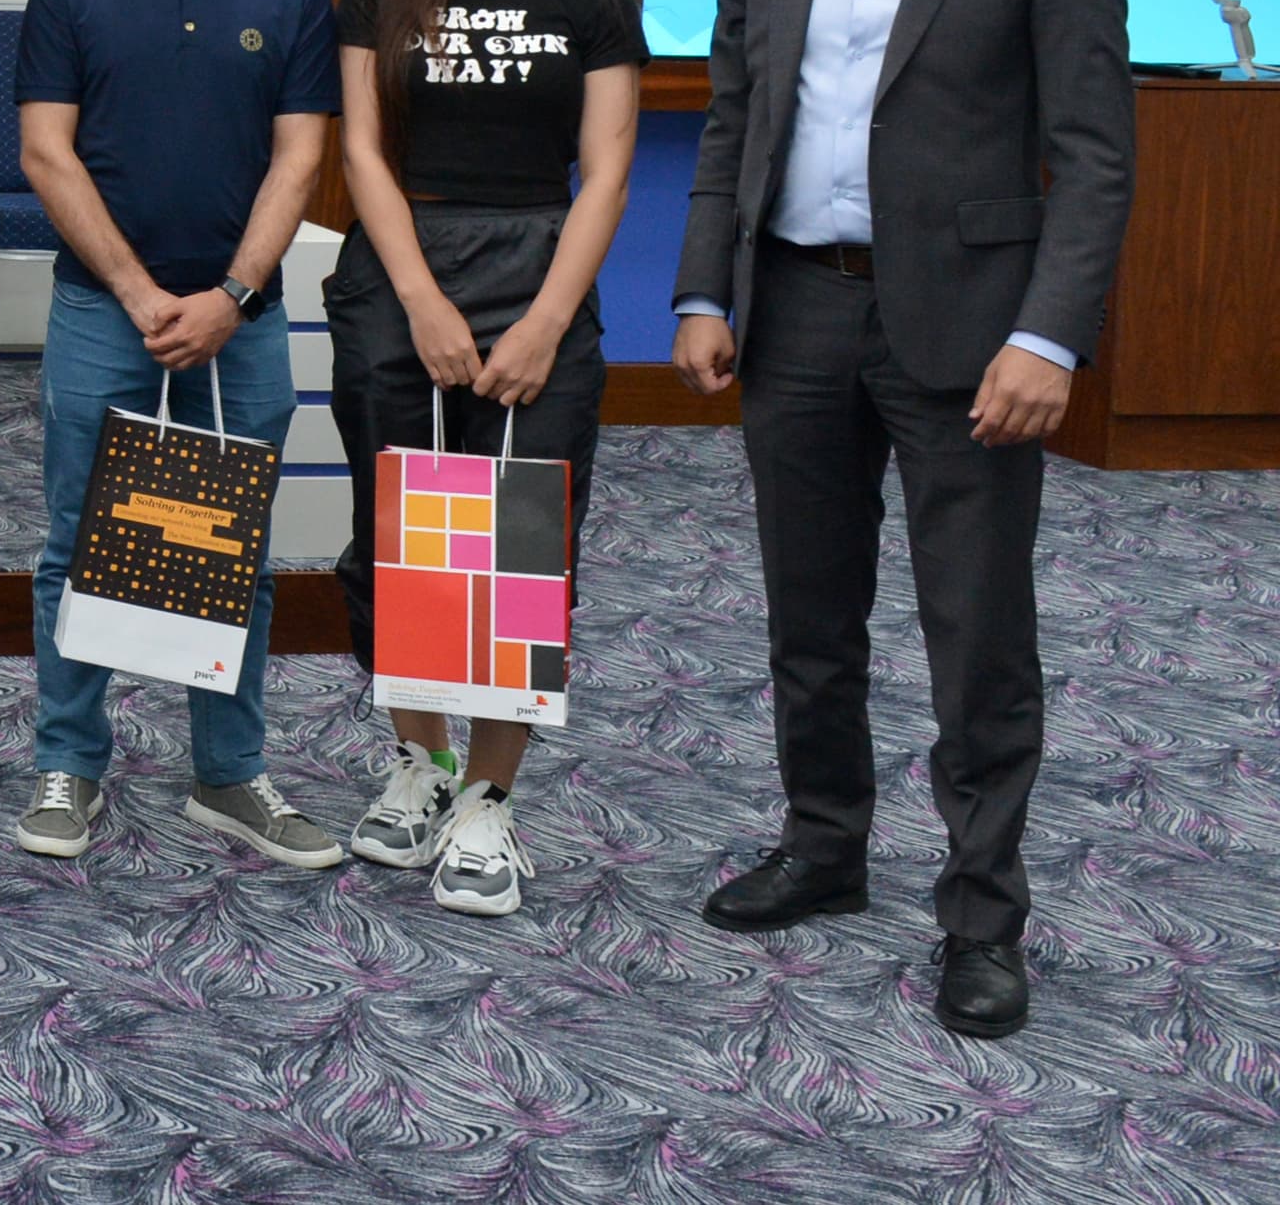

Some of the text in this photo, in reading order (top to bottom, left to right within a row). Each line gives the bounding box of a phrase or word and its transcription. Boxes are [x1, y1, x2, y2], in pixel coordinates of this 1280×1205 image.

[425, 57, 533, 84] WAY!
[134, 495, 175, 513] Solving
[178, 504, 227, 523] Together
[193, 668, 217, 681] pwc
[516, 706, 541, 717] pwc
